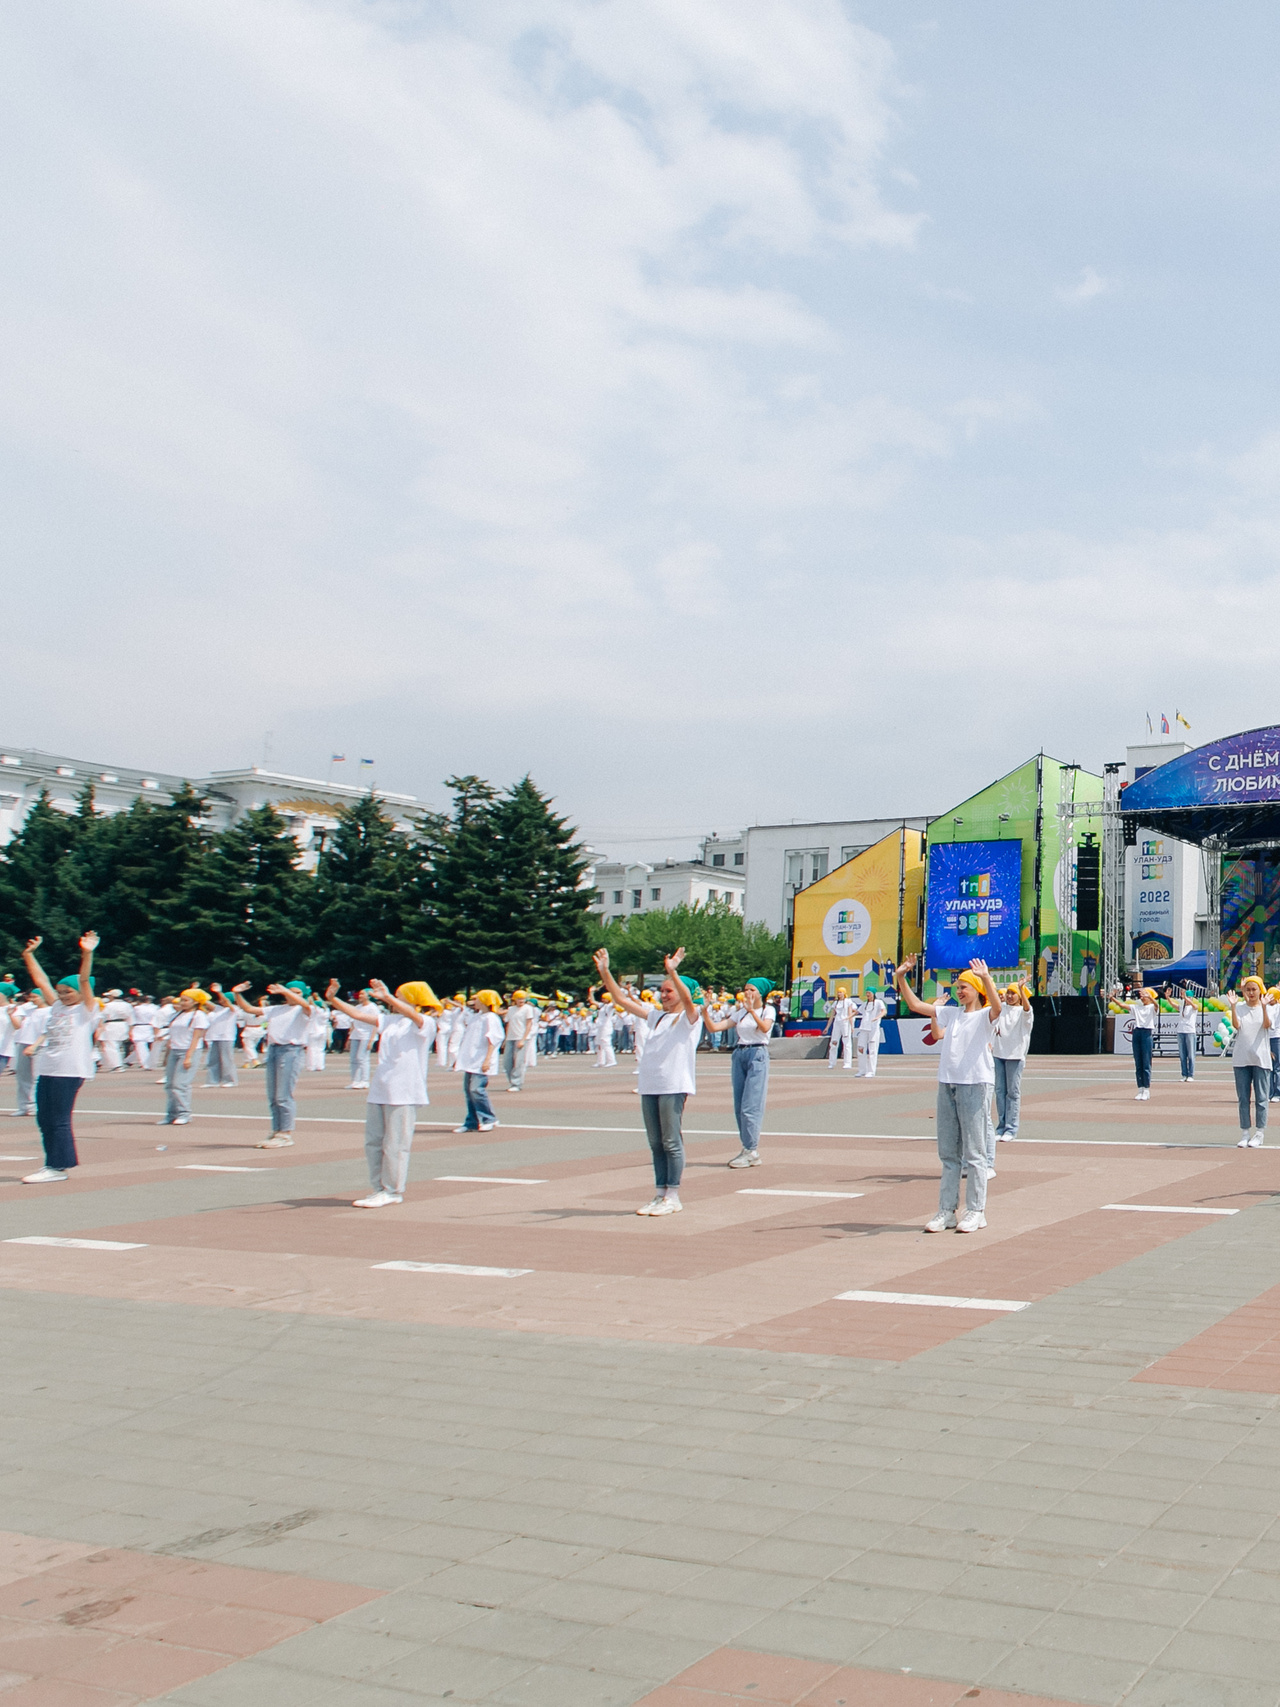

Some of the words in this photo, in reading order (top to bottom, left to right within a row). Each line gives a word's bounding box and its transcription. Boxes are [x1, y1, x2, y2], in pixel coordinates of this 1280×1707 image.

[1208, 756, 1221, 771] С
[1225, 750, 1279, 771] ДНЁМ
[1140, 890, 1170, 903] 2022
[945, 898, 1003, 911] УЛАН-УДЭ
